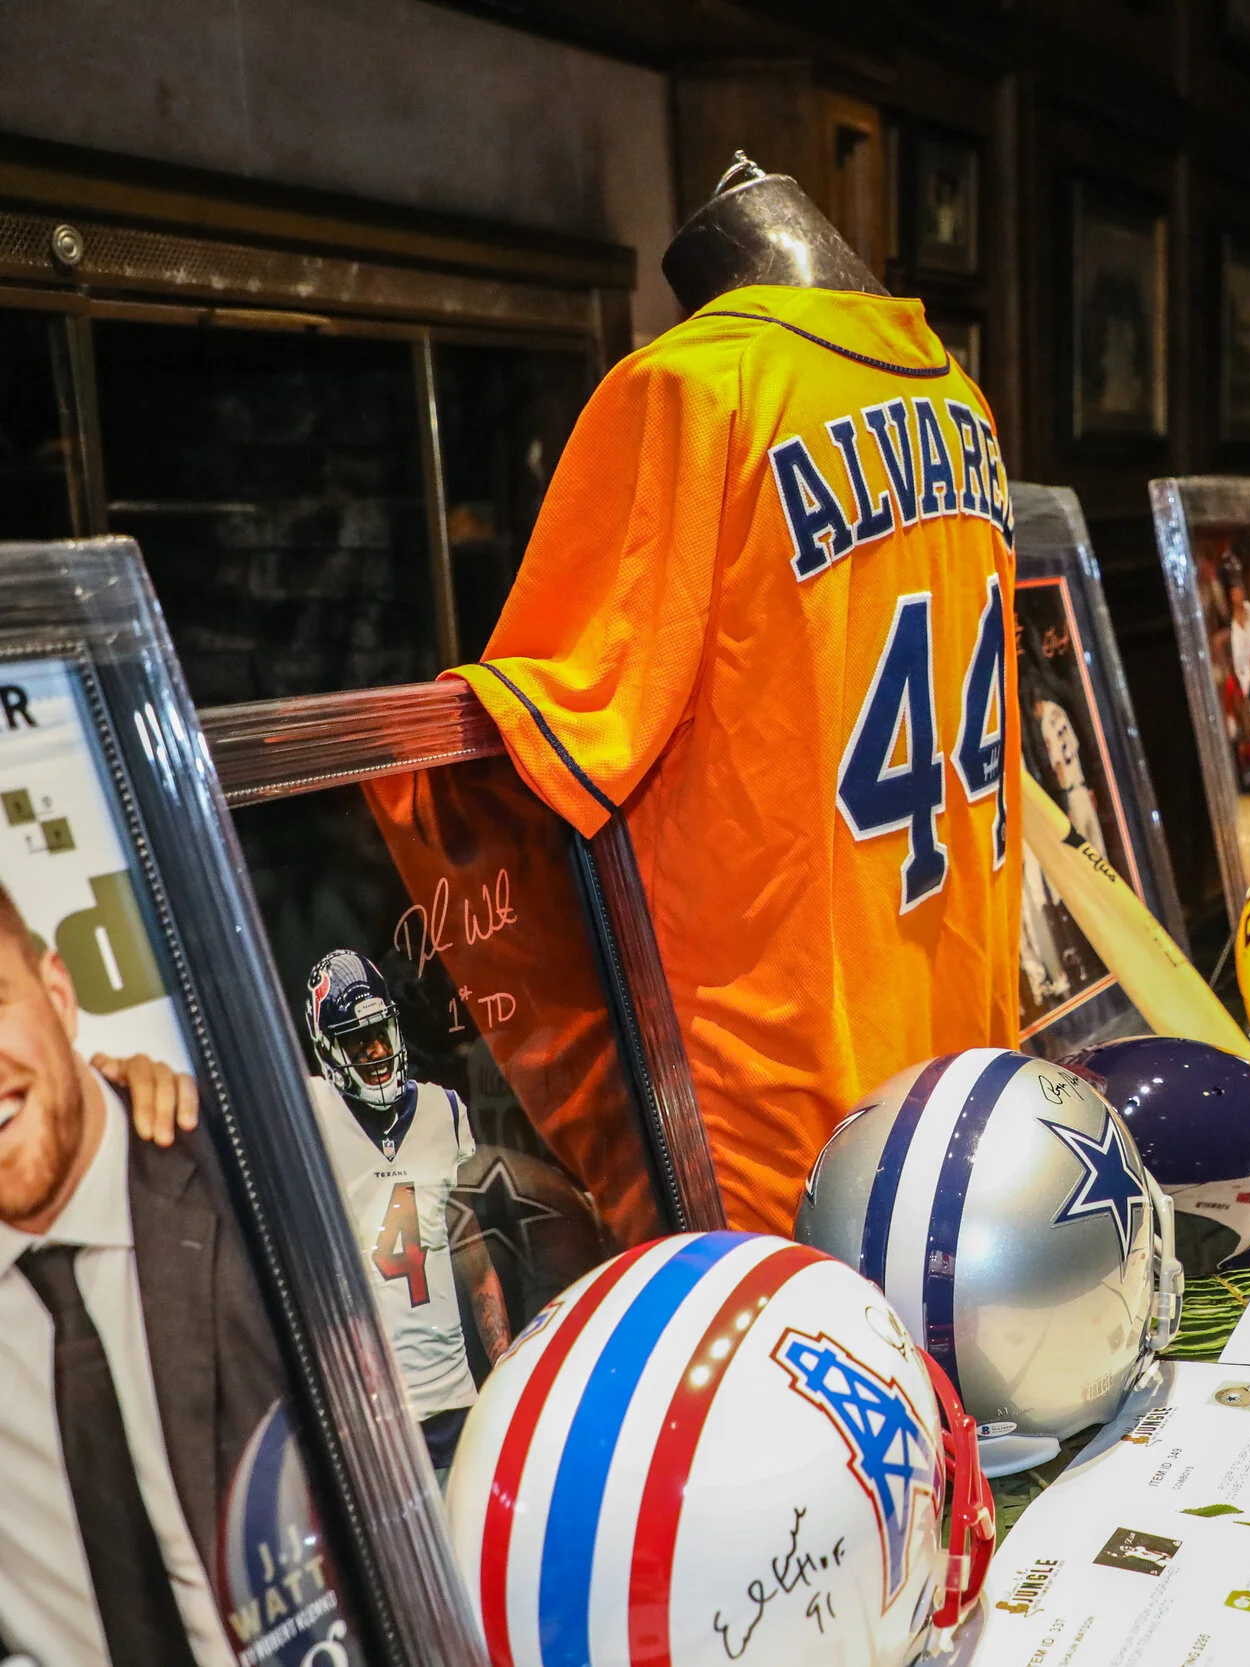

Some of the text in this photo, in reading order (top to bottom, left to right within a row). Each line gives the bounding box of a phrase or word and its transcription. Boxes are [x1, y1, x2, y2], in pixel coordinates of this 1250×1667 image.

[768, 397, 1016, 582] ALVARE
[836, 572, 1008, 915] 44
[477, 992, 517, 1029] TD
[374, 1170, 408, 1178] TEXANS
[371, 1181, 431, 1309] 4
[1134, 1406, 1173, 1436] JUNGLE
[1148, 1470, 1167, 1488] ITEM
[229, 1555, 325, 1643] WATT
[1012, 1558, 1059, 1604] JUNGLE
